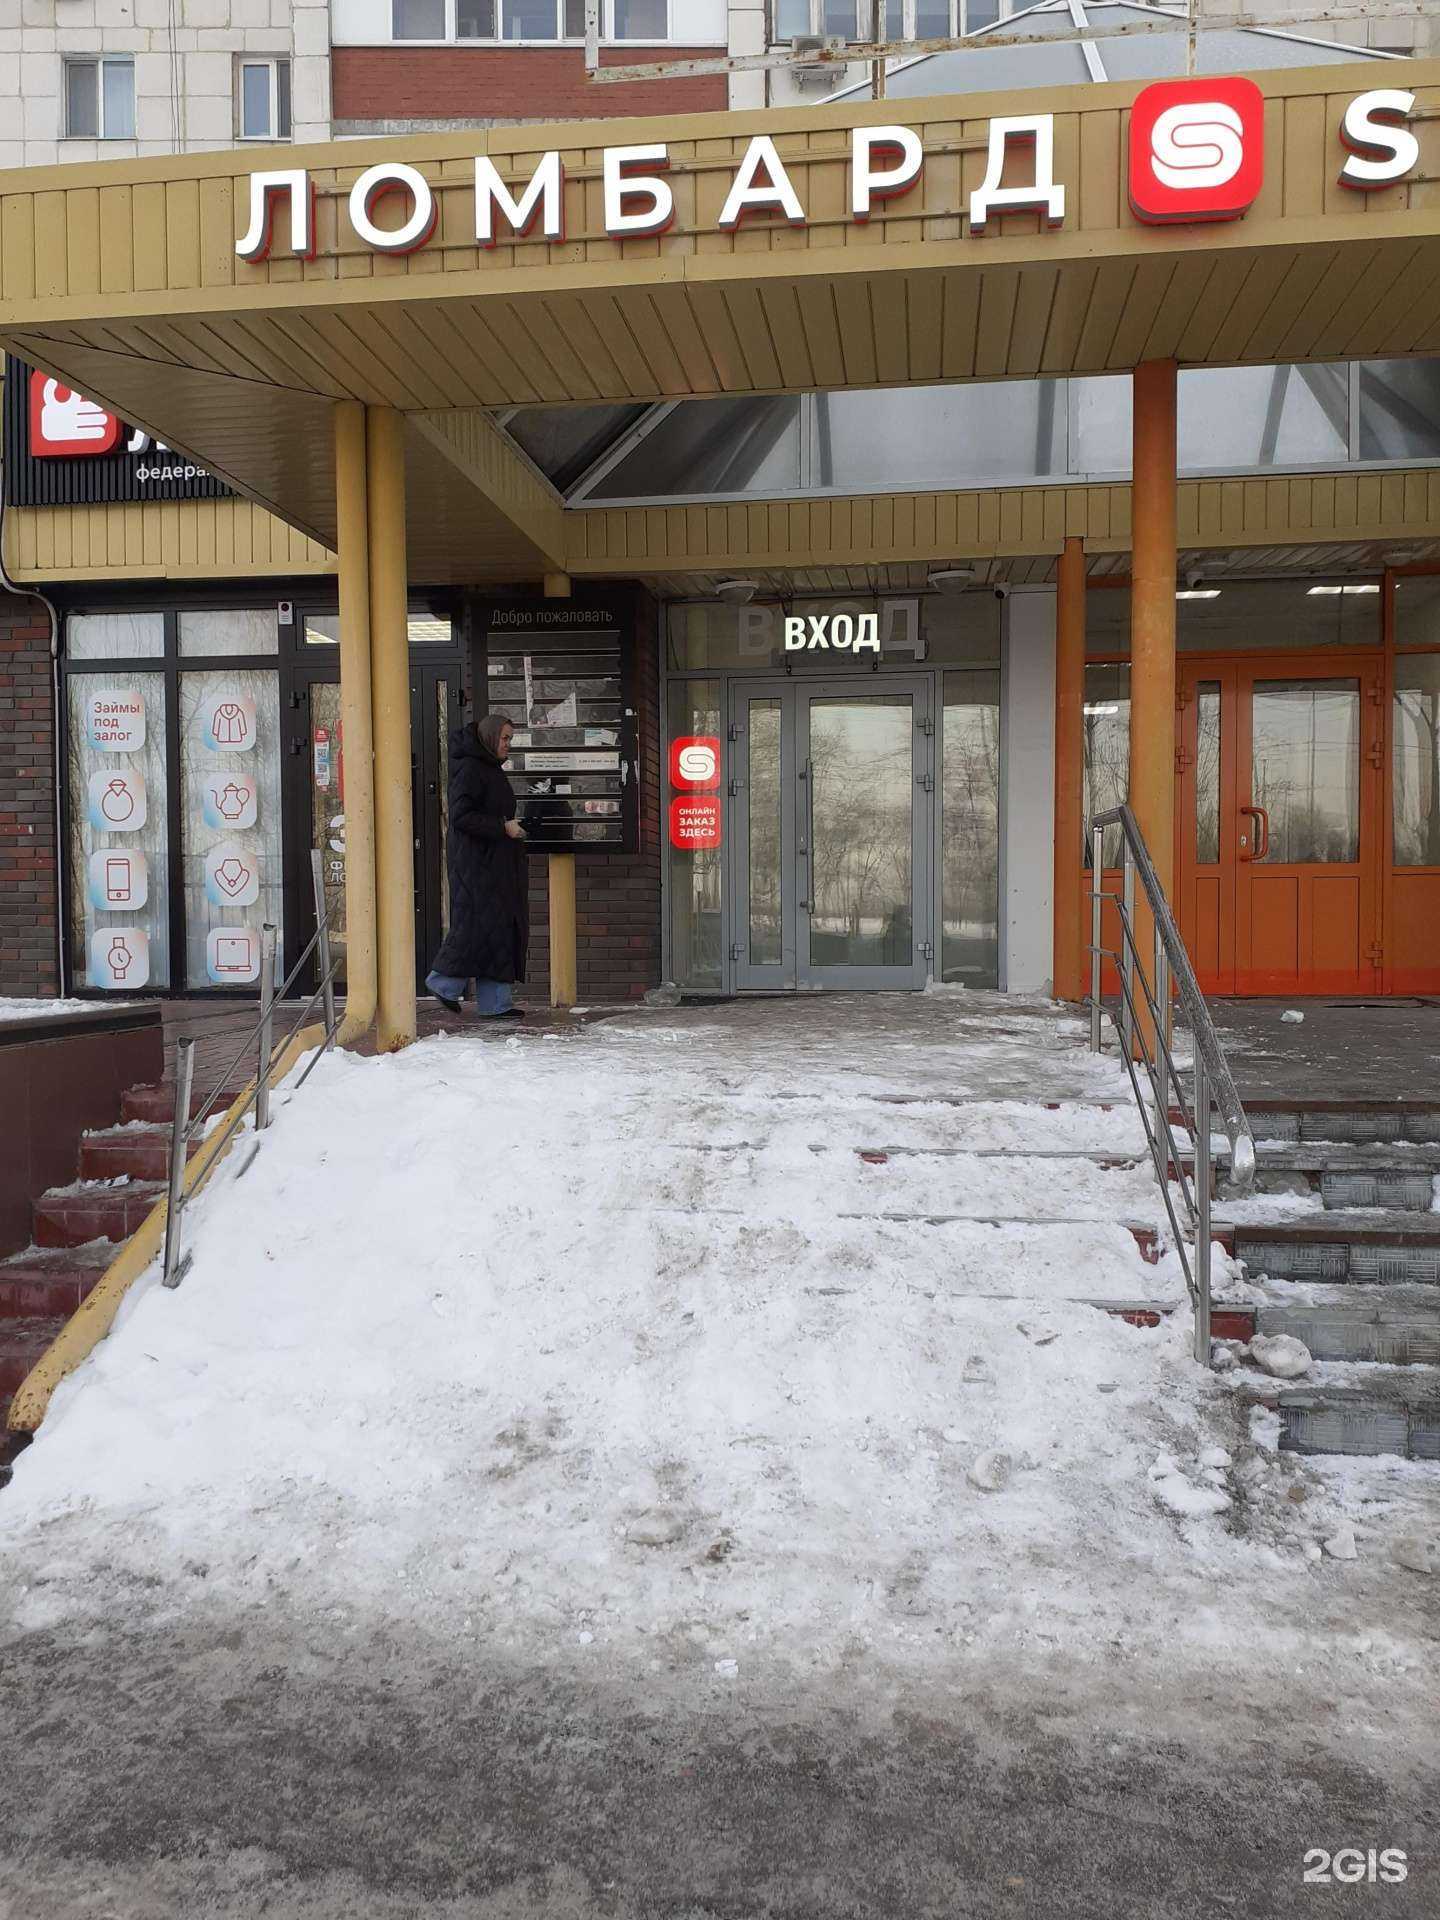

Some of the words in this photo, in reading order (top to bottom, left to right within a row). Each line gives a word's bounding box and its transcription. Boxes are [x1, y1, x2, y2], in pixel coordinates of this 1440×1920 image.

[236, 114, 1066, 260] ЛОМБАРД
[136, 463, 210, 483] федера
[492, 610, 533, 626] Добро
[536, 610, 613, 624] пожаловать
[785, 613, 881, 653] ВХОД
[94, 701, 140, 713] Займы
[94, 718, 119, 728] под
[94, 731, 132, 741] залог
[679, 807, 716, 815] ОНЛАЙН
[679, 817, 716, 826] ЗАКАЗ
[679, 828, 716, 838] ЗДЕСЬ
